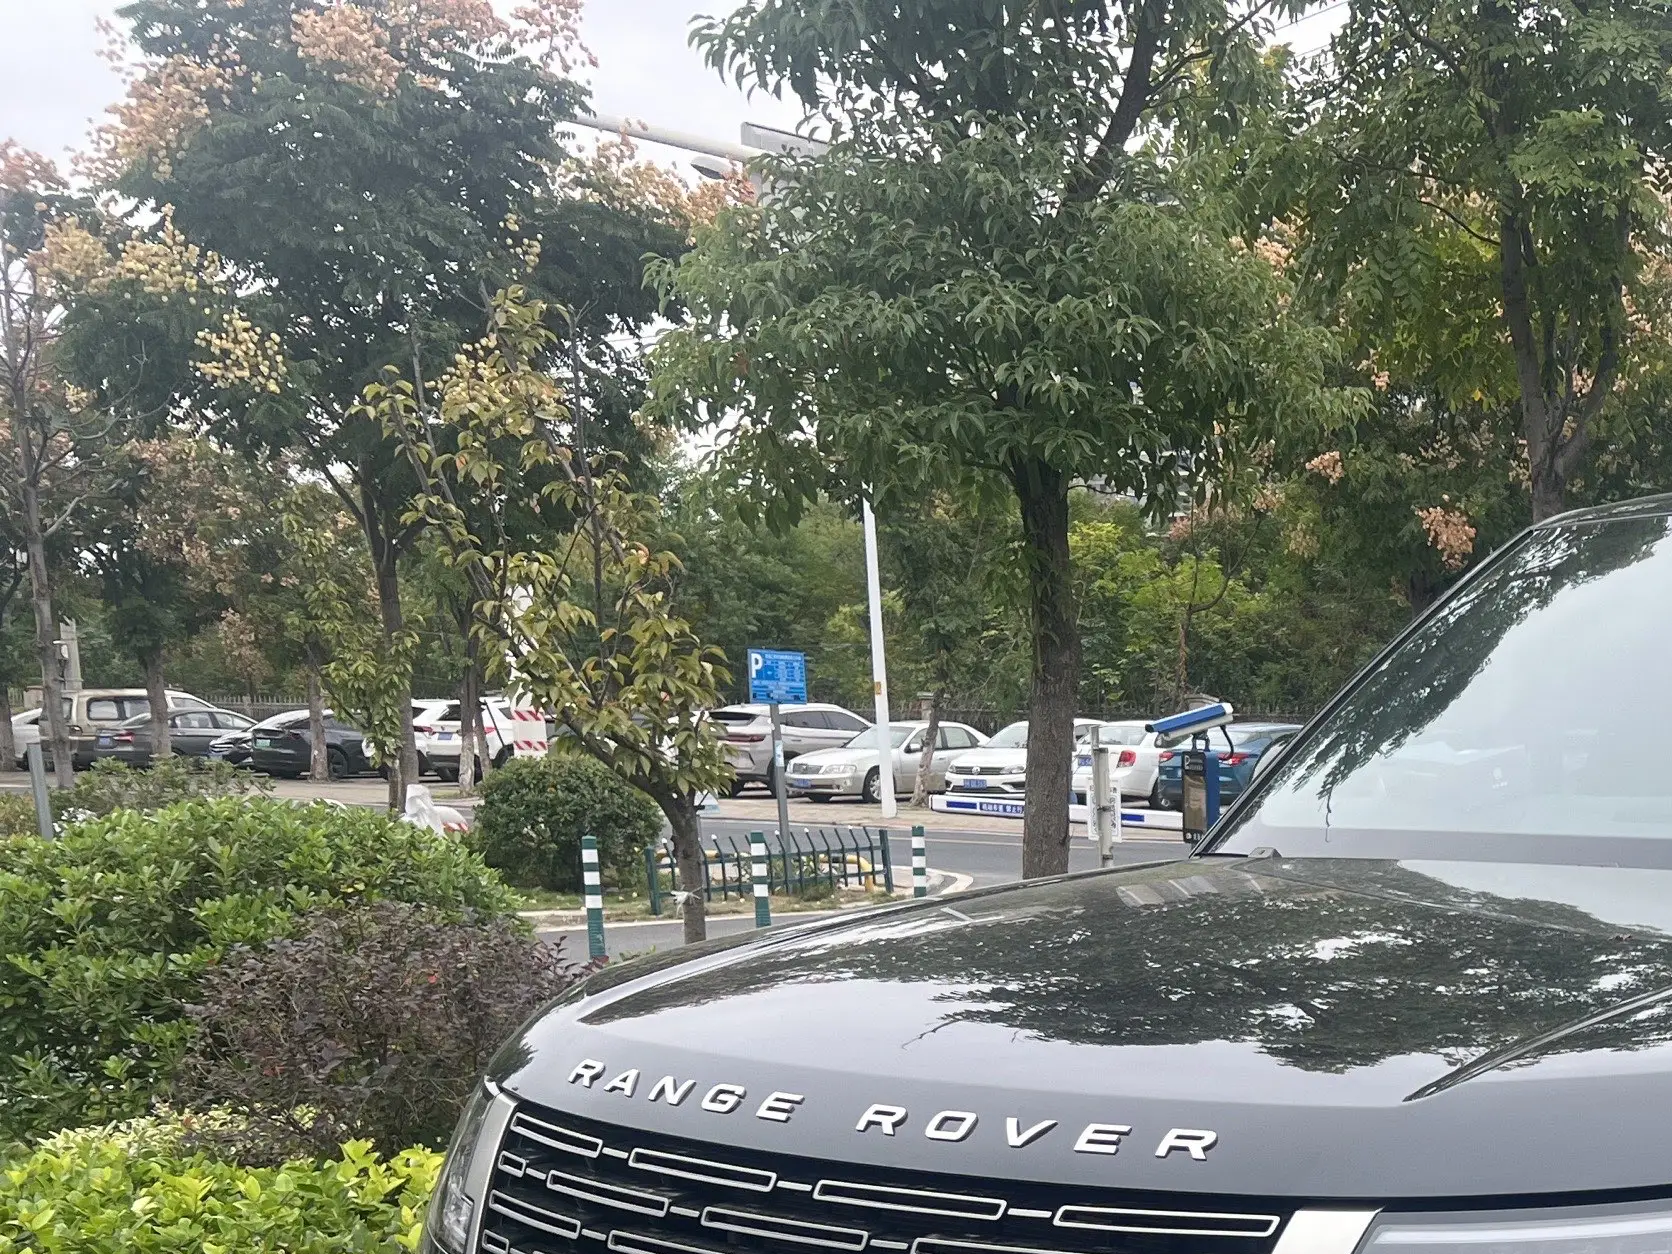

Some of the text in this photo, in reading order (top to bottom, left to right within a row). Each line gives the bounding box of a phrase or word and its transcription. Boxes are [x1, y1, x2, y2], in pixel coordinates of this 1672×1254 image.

[751, 653, 763, 679] P
[567, 1058, 1219, 1161] RANGE ROVER
